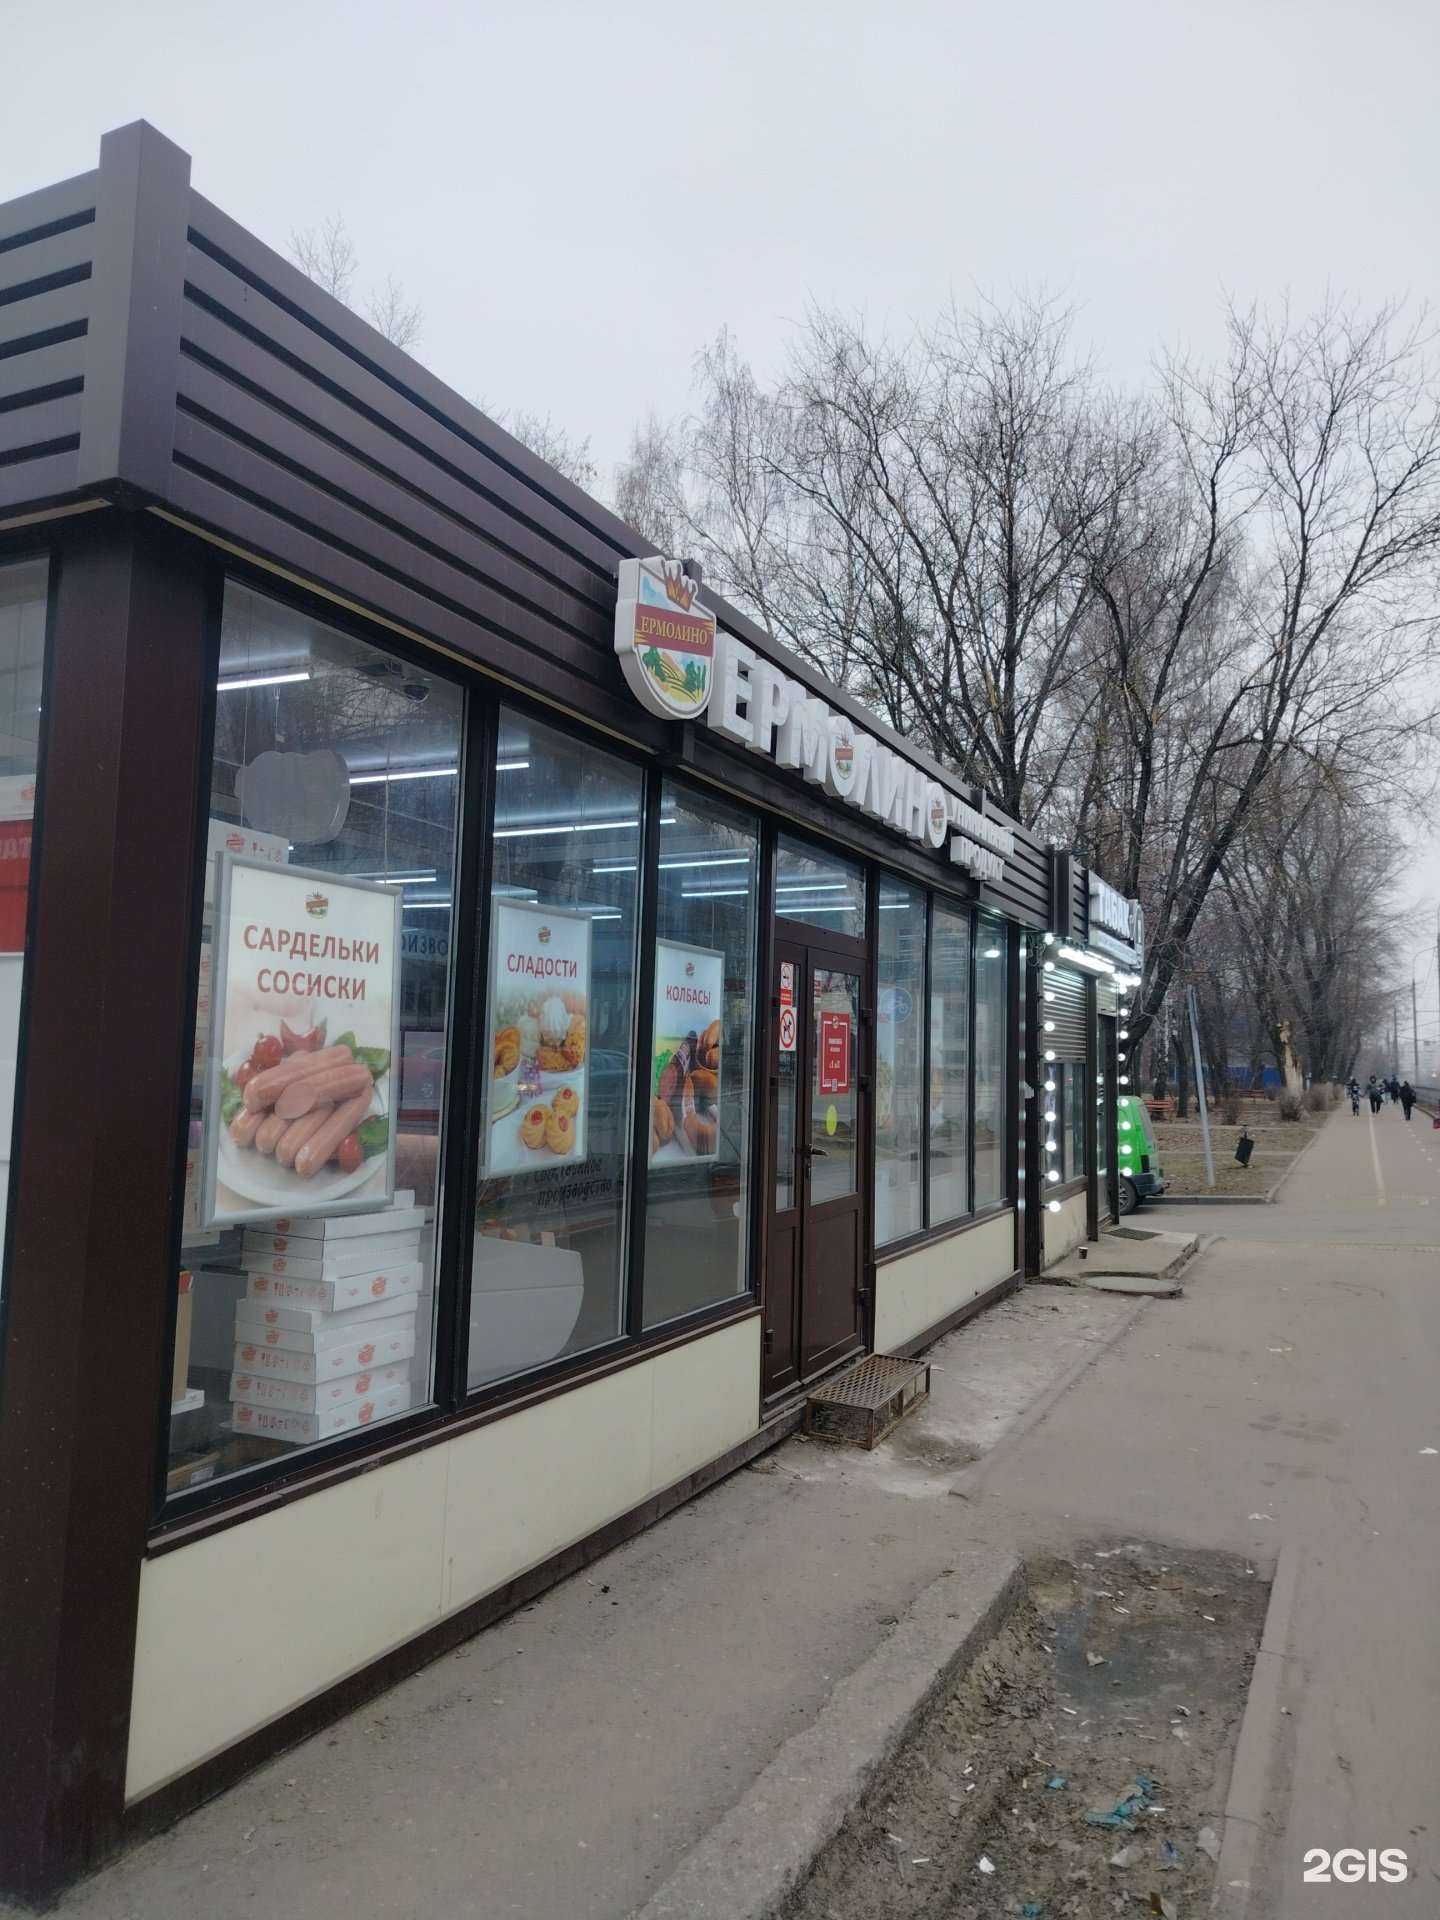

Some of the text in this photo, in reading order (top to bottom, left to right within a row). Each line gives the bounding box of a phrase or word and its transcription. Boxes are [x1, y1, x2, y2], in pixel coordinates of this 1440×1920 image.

[640, 616, 708, 645] ЕРМОЛИНО
[709, 632, 948, 849] ЕРМОЛИНО
[243, 925, 379, 964] САРДЕЛЬКИ
[507, 954, 577, 978] СЛАДОСТИ
[257, 968, 366, 1000] СОСИСКИ
[666, 984, 711, 1006] КОЛБАСЫ
